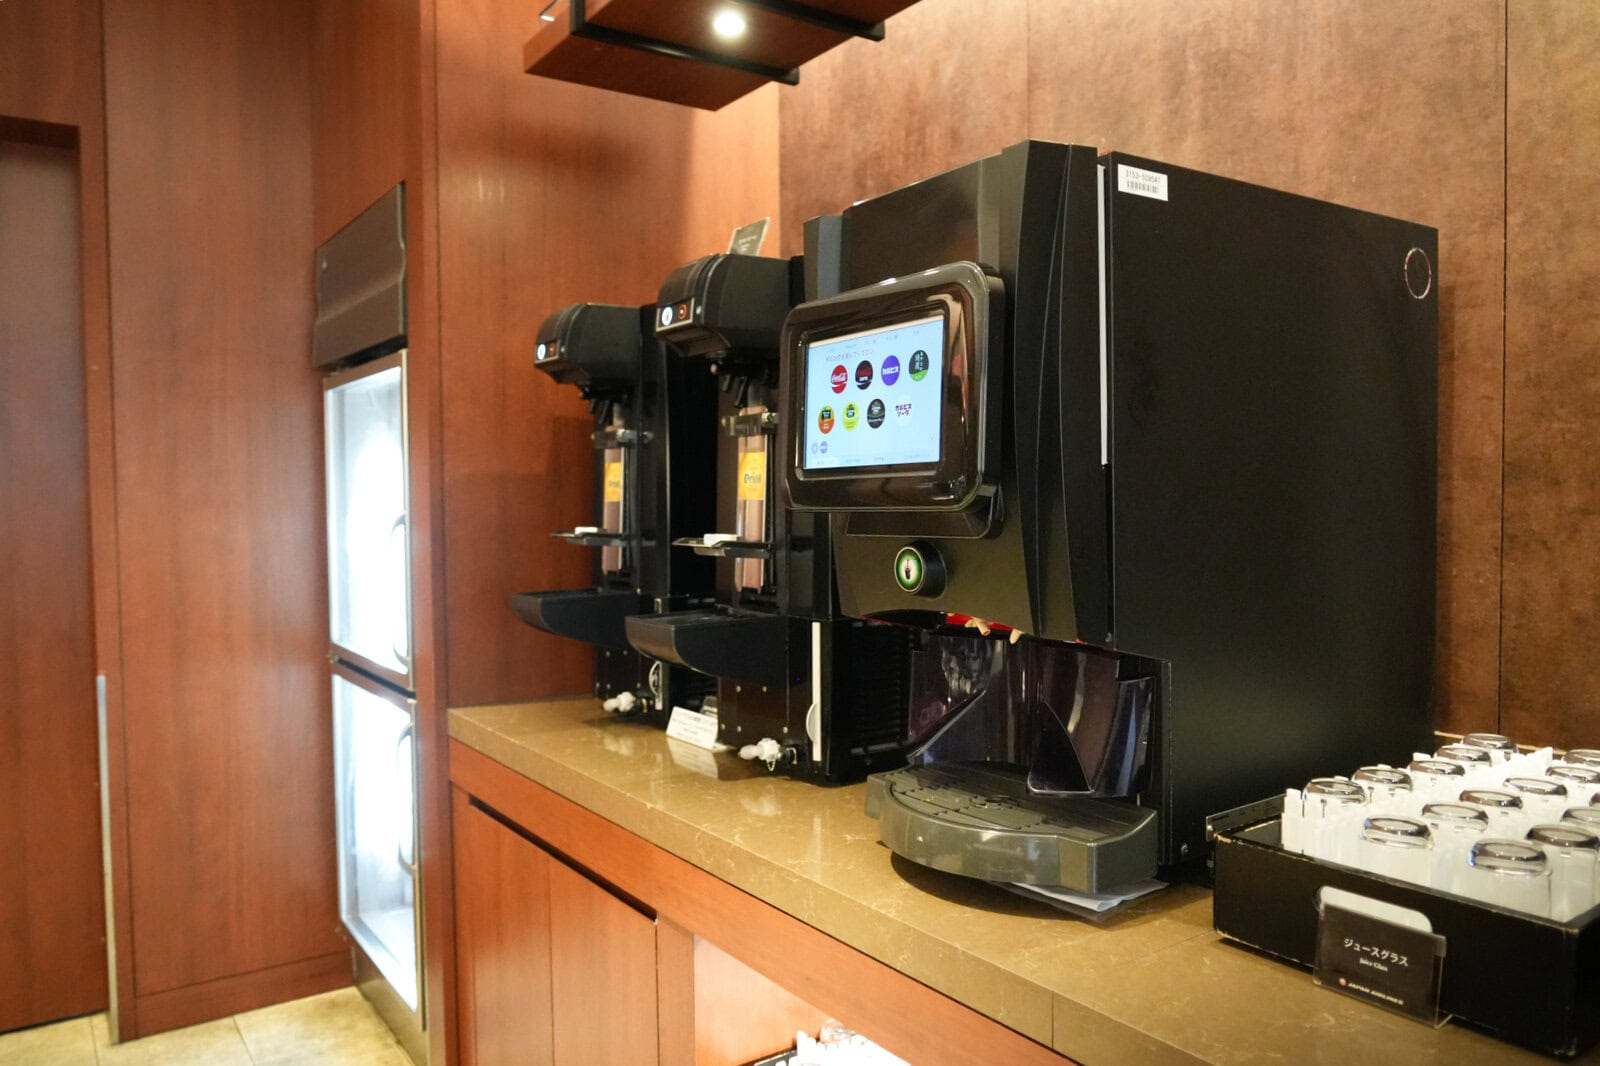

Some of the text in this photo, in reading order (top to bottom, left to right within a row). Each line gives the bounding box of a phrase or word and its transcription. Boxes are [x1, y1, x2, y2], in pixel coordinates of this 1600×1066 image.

[1344, 938, 1408, 967] ジュースグラス
